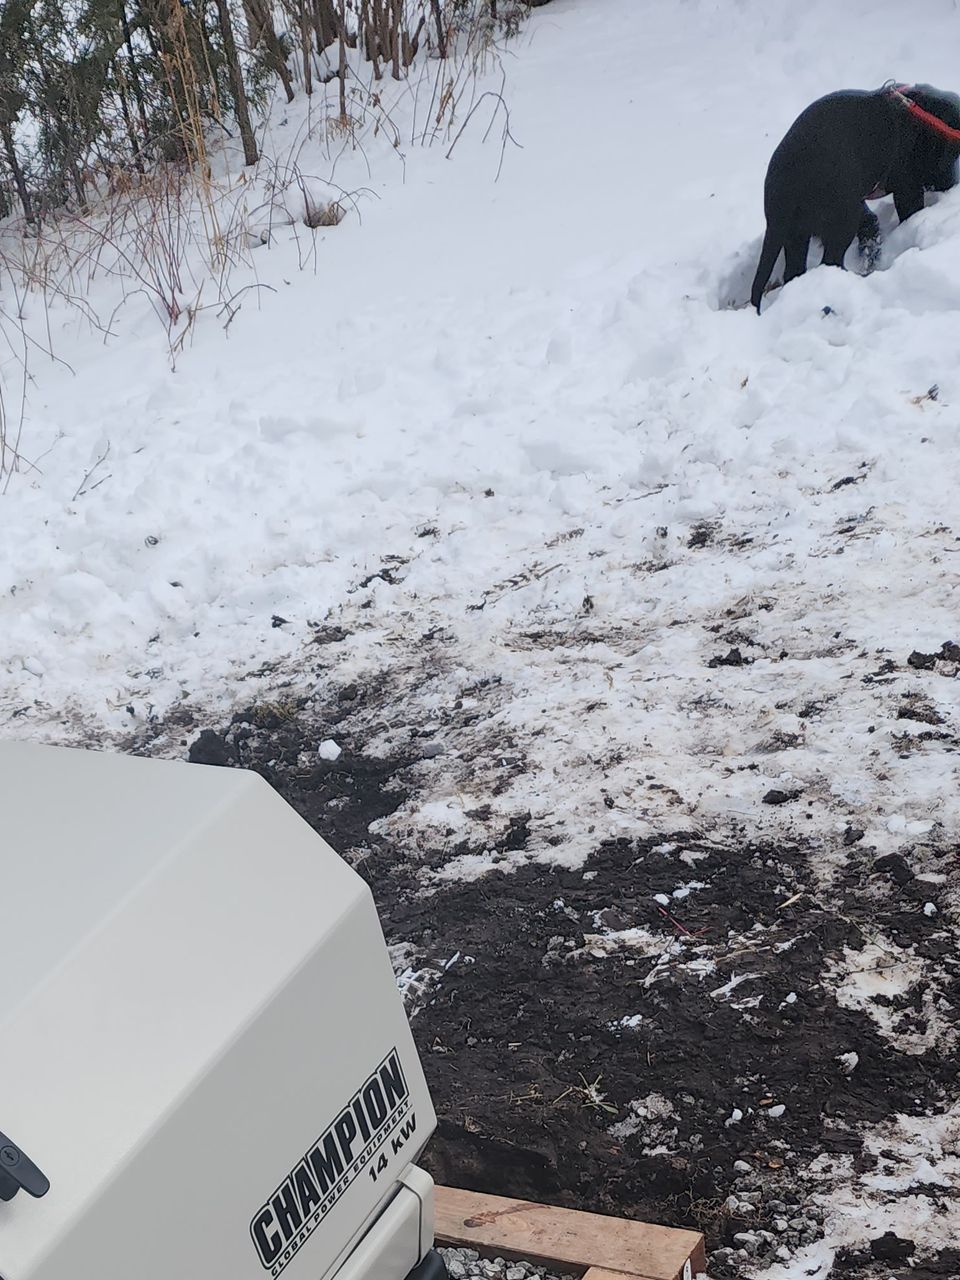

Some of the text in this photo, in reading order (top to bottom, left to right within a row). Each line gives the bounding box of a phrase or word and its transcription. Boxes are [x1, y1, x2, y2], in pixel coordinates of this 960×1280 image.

[251, 1053, 408, 1266] CHAMPION
[271, 1101, 413, 1277] GLOBAL POWER EQUIPMENT
[368, 1112, 418, 1183] 14 kW
